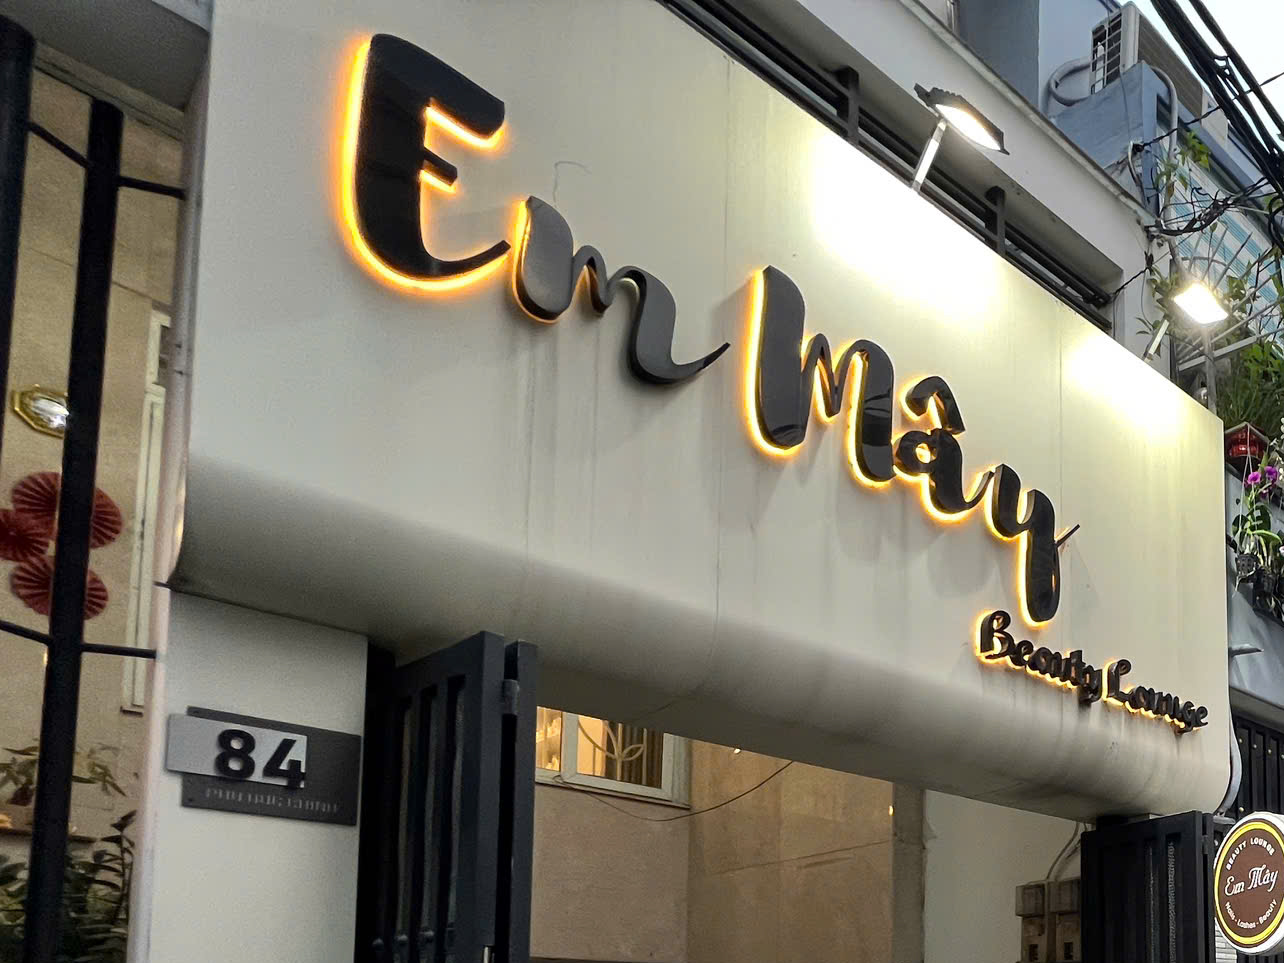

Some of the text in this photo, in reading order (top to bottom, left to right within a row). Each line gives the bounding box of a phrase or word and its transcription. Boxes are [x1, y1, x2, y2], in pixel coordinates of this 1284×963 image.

[352, 33, 1080, 624] Em Mây
[978, 610, 1208, 736] Beauty Lounge
[216, 729, 306, 790] 84
[1226, 837, 1276, 870] BEAUTY LOUNGE
[1224, 864, 1279, 896] Em Mây
[1225, 901, 1236, 921] Nails
[1259, 899, 1277, 925] Beauty
